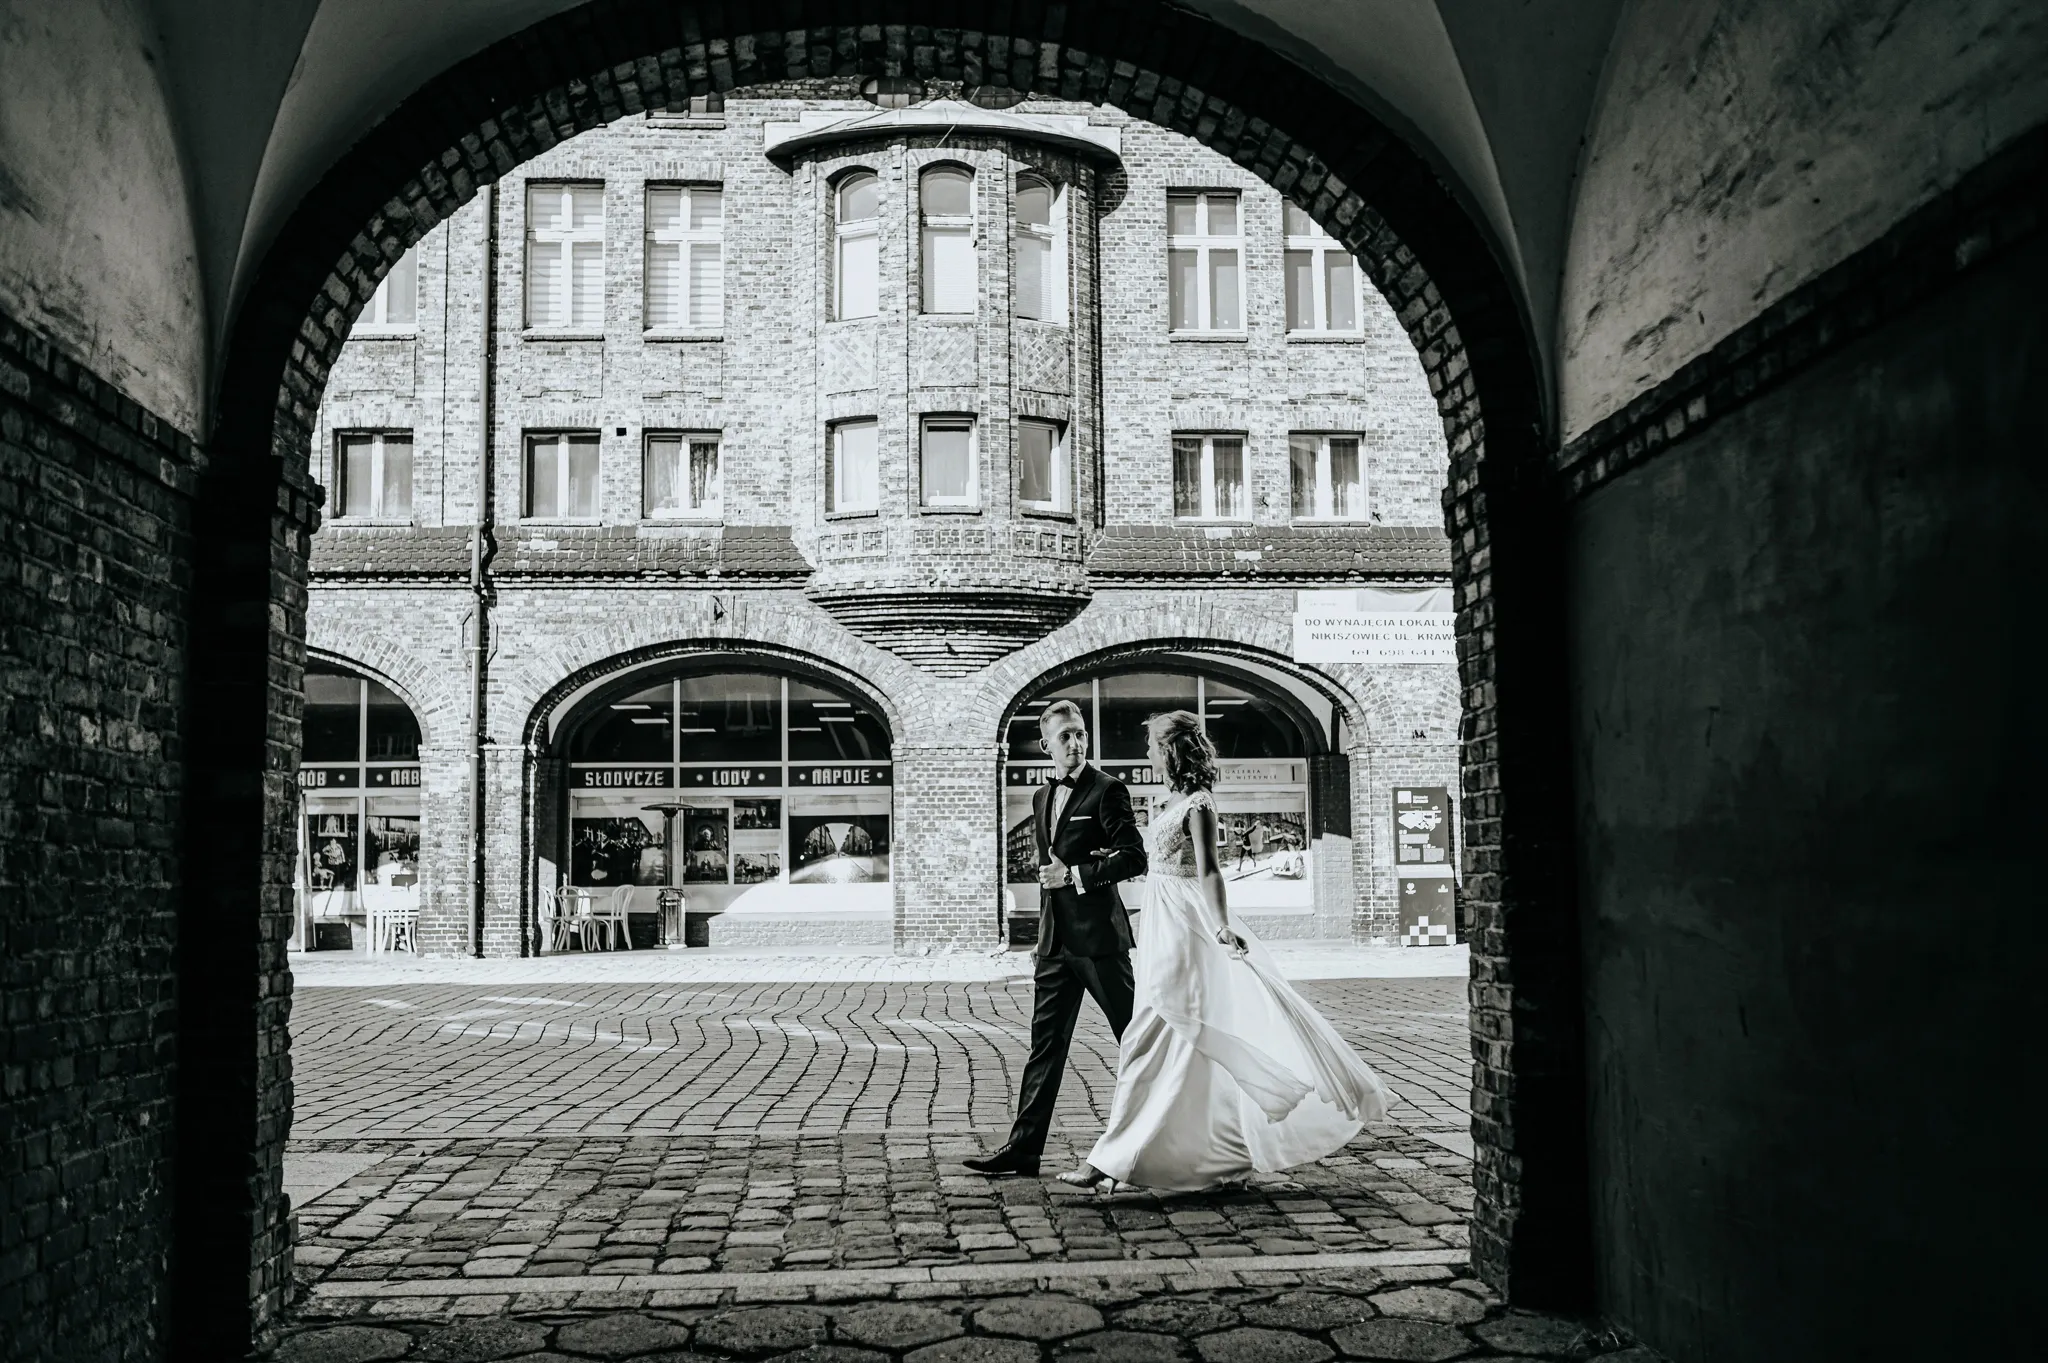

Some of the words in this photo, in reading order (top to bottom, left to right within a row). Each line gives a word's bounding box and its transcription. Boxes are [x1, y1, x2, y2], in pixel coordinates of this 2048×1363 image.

[1304, 618, 1321, 627] DO
[1325, 618, 1396, 628] WYNAJĘCIA
[1399, 618, 1438, 627] LOKAL
[1311, 632, 1391, 641] NIKISZOWIEC
[1394, 632, 1413, 641] UL.
[585, 770, 665, 786] SŁODYCZE
[712, 769, 751, 786] LODY
[812, 768, 870, 785] NAPOJE
